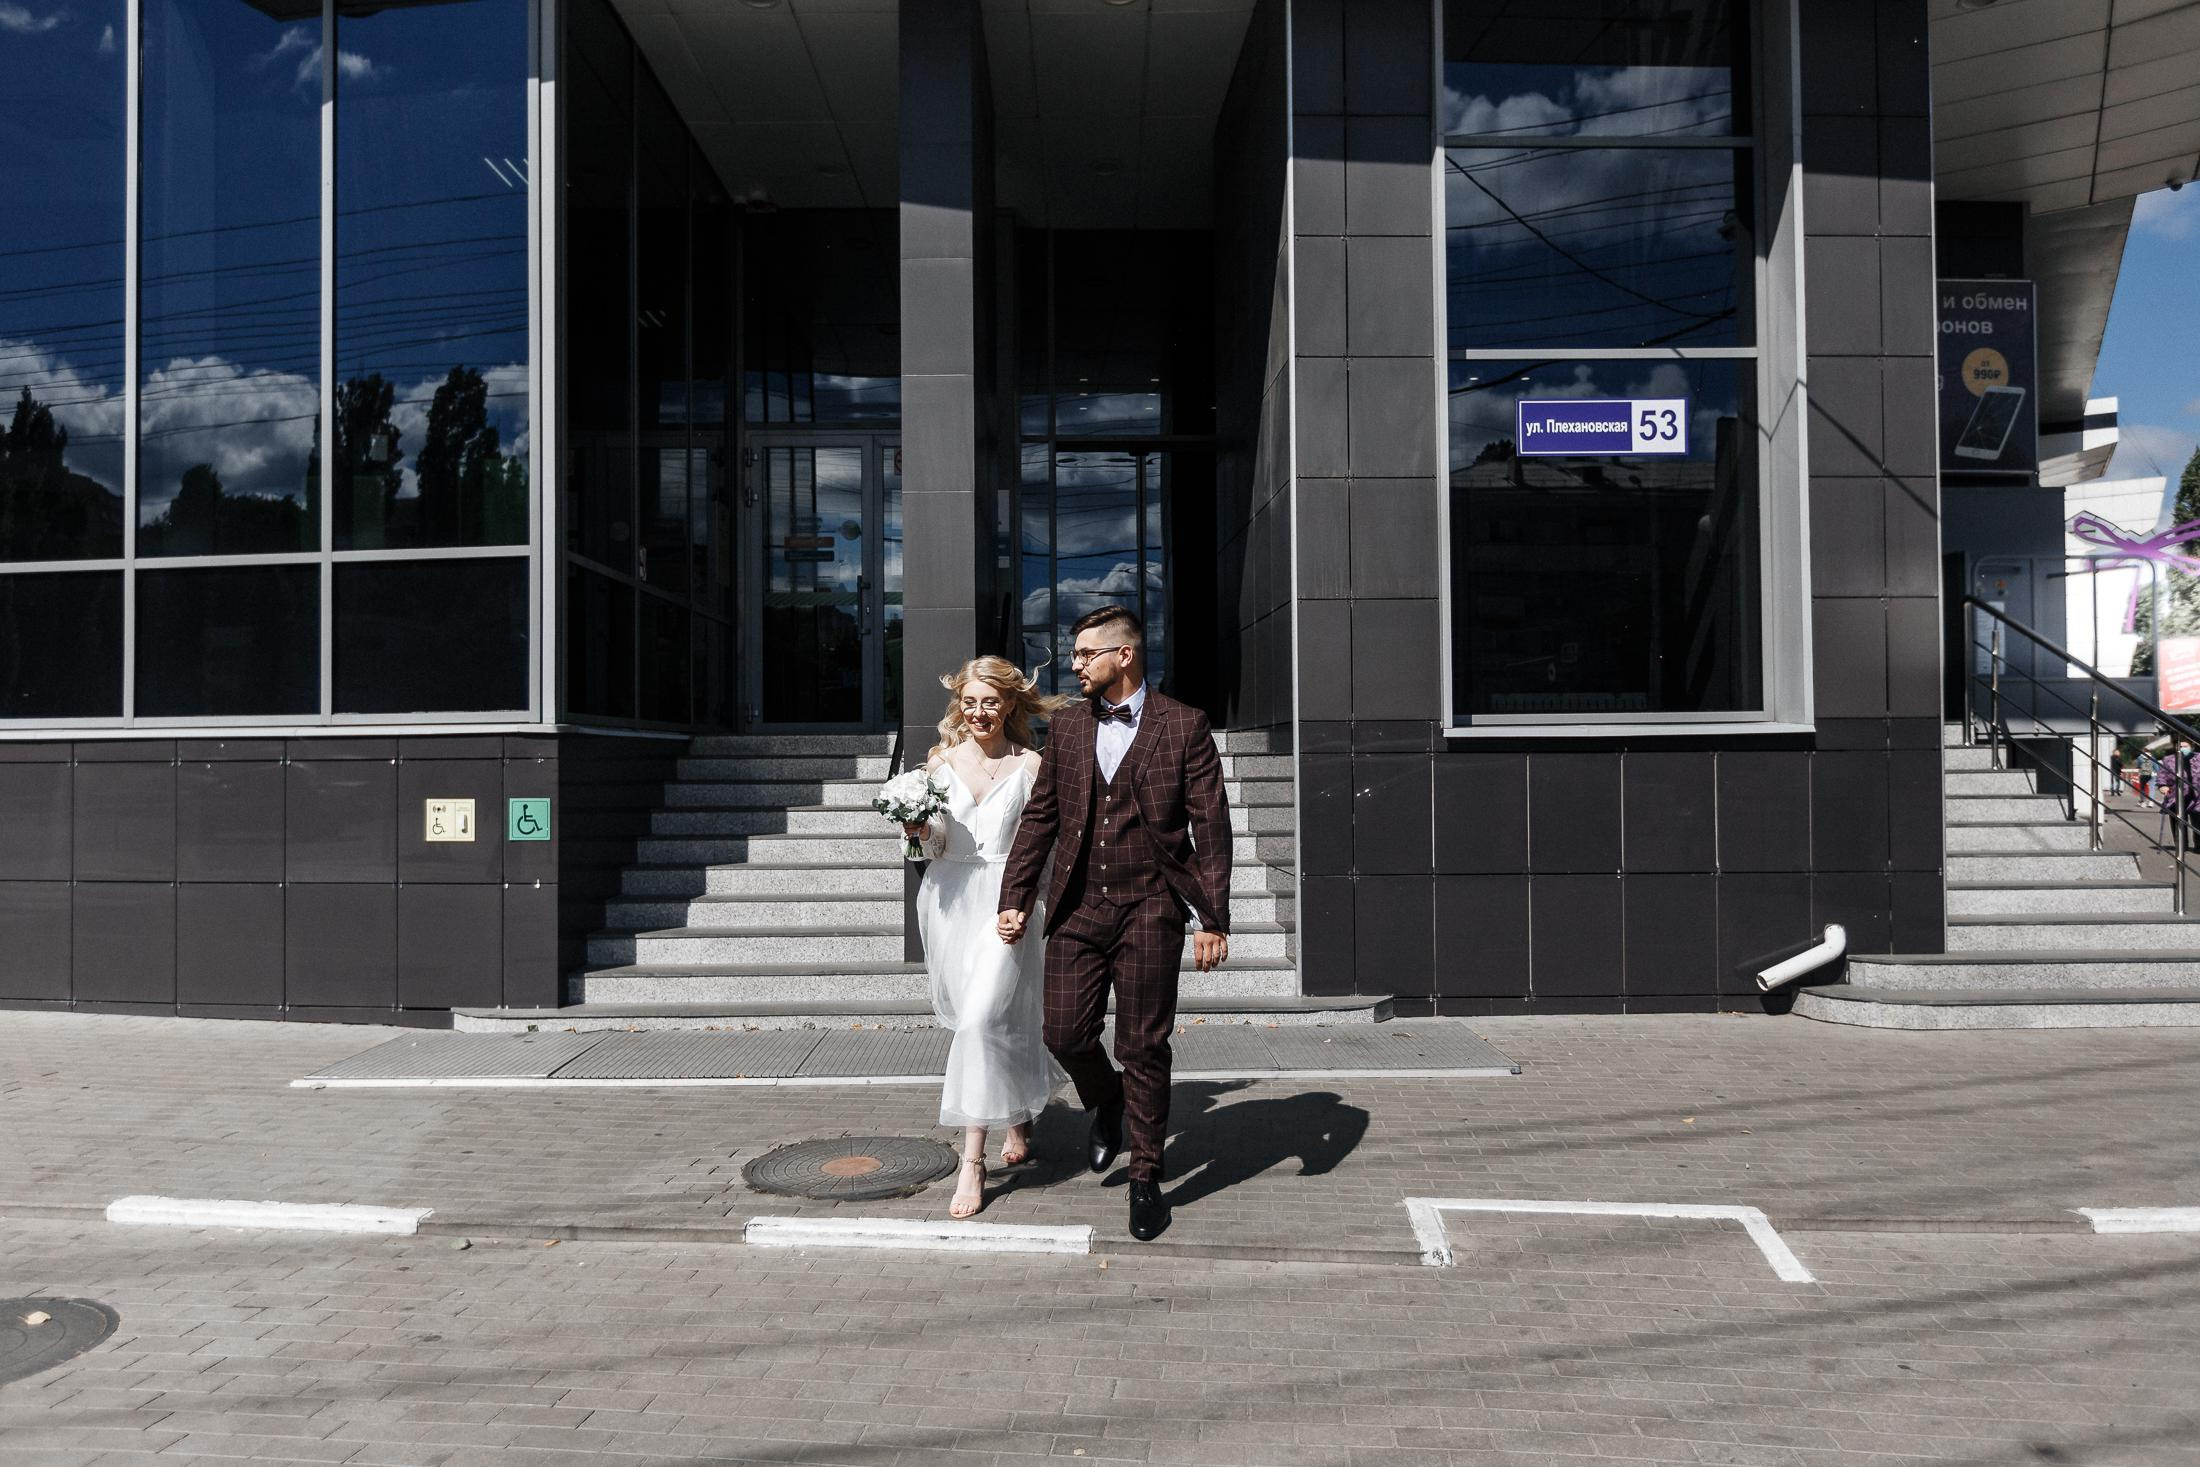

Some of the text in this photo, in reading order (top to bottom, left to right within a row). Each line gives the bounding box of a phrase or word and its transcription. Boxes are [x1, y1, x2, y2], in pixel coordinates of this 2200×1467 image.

[1943, 292, 2027, 311] и обмен
[1526, 409, 1678, 441] ул. Плехановская 53
